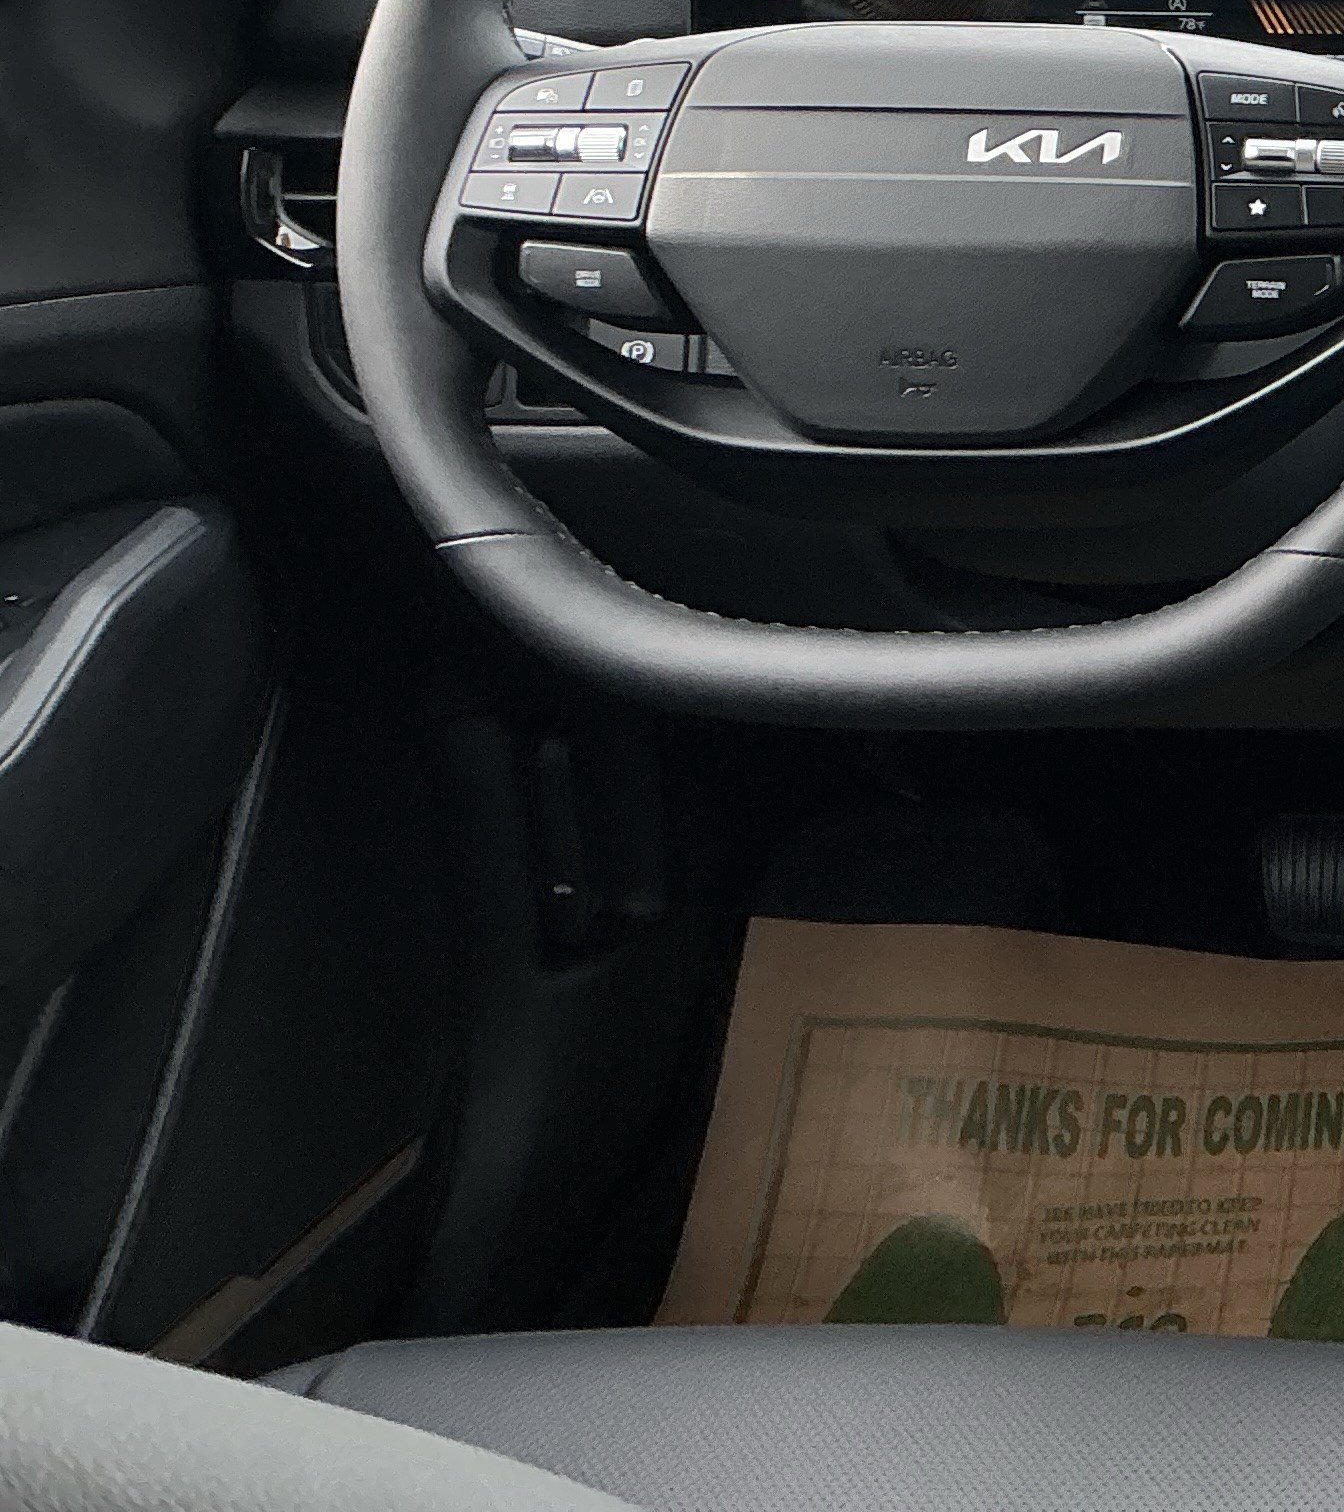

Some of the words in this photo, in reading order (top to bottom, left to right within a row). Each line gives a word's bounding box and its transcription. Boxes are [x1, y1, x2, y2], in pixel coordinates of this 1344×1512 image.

[1231, 93, 1268, 105] MODE
[898, 1076, 1087, 1158] THANKS
[1097, 1091, 1185, 1160] FOR
